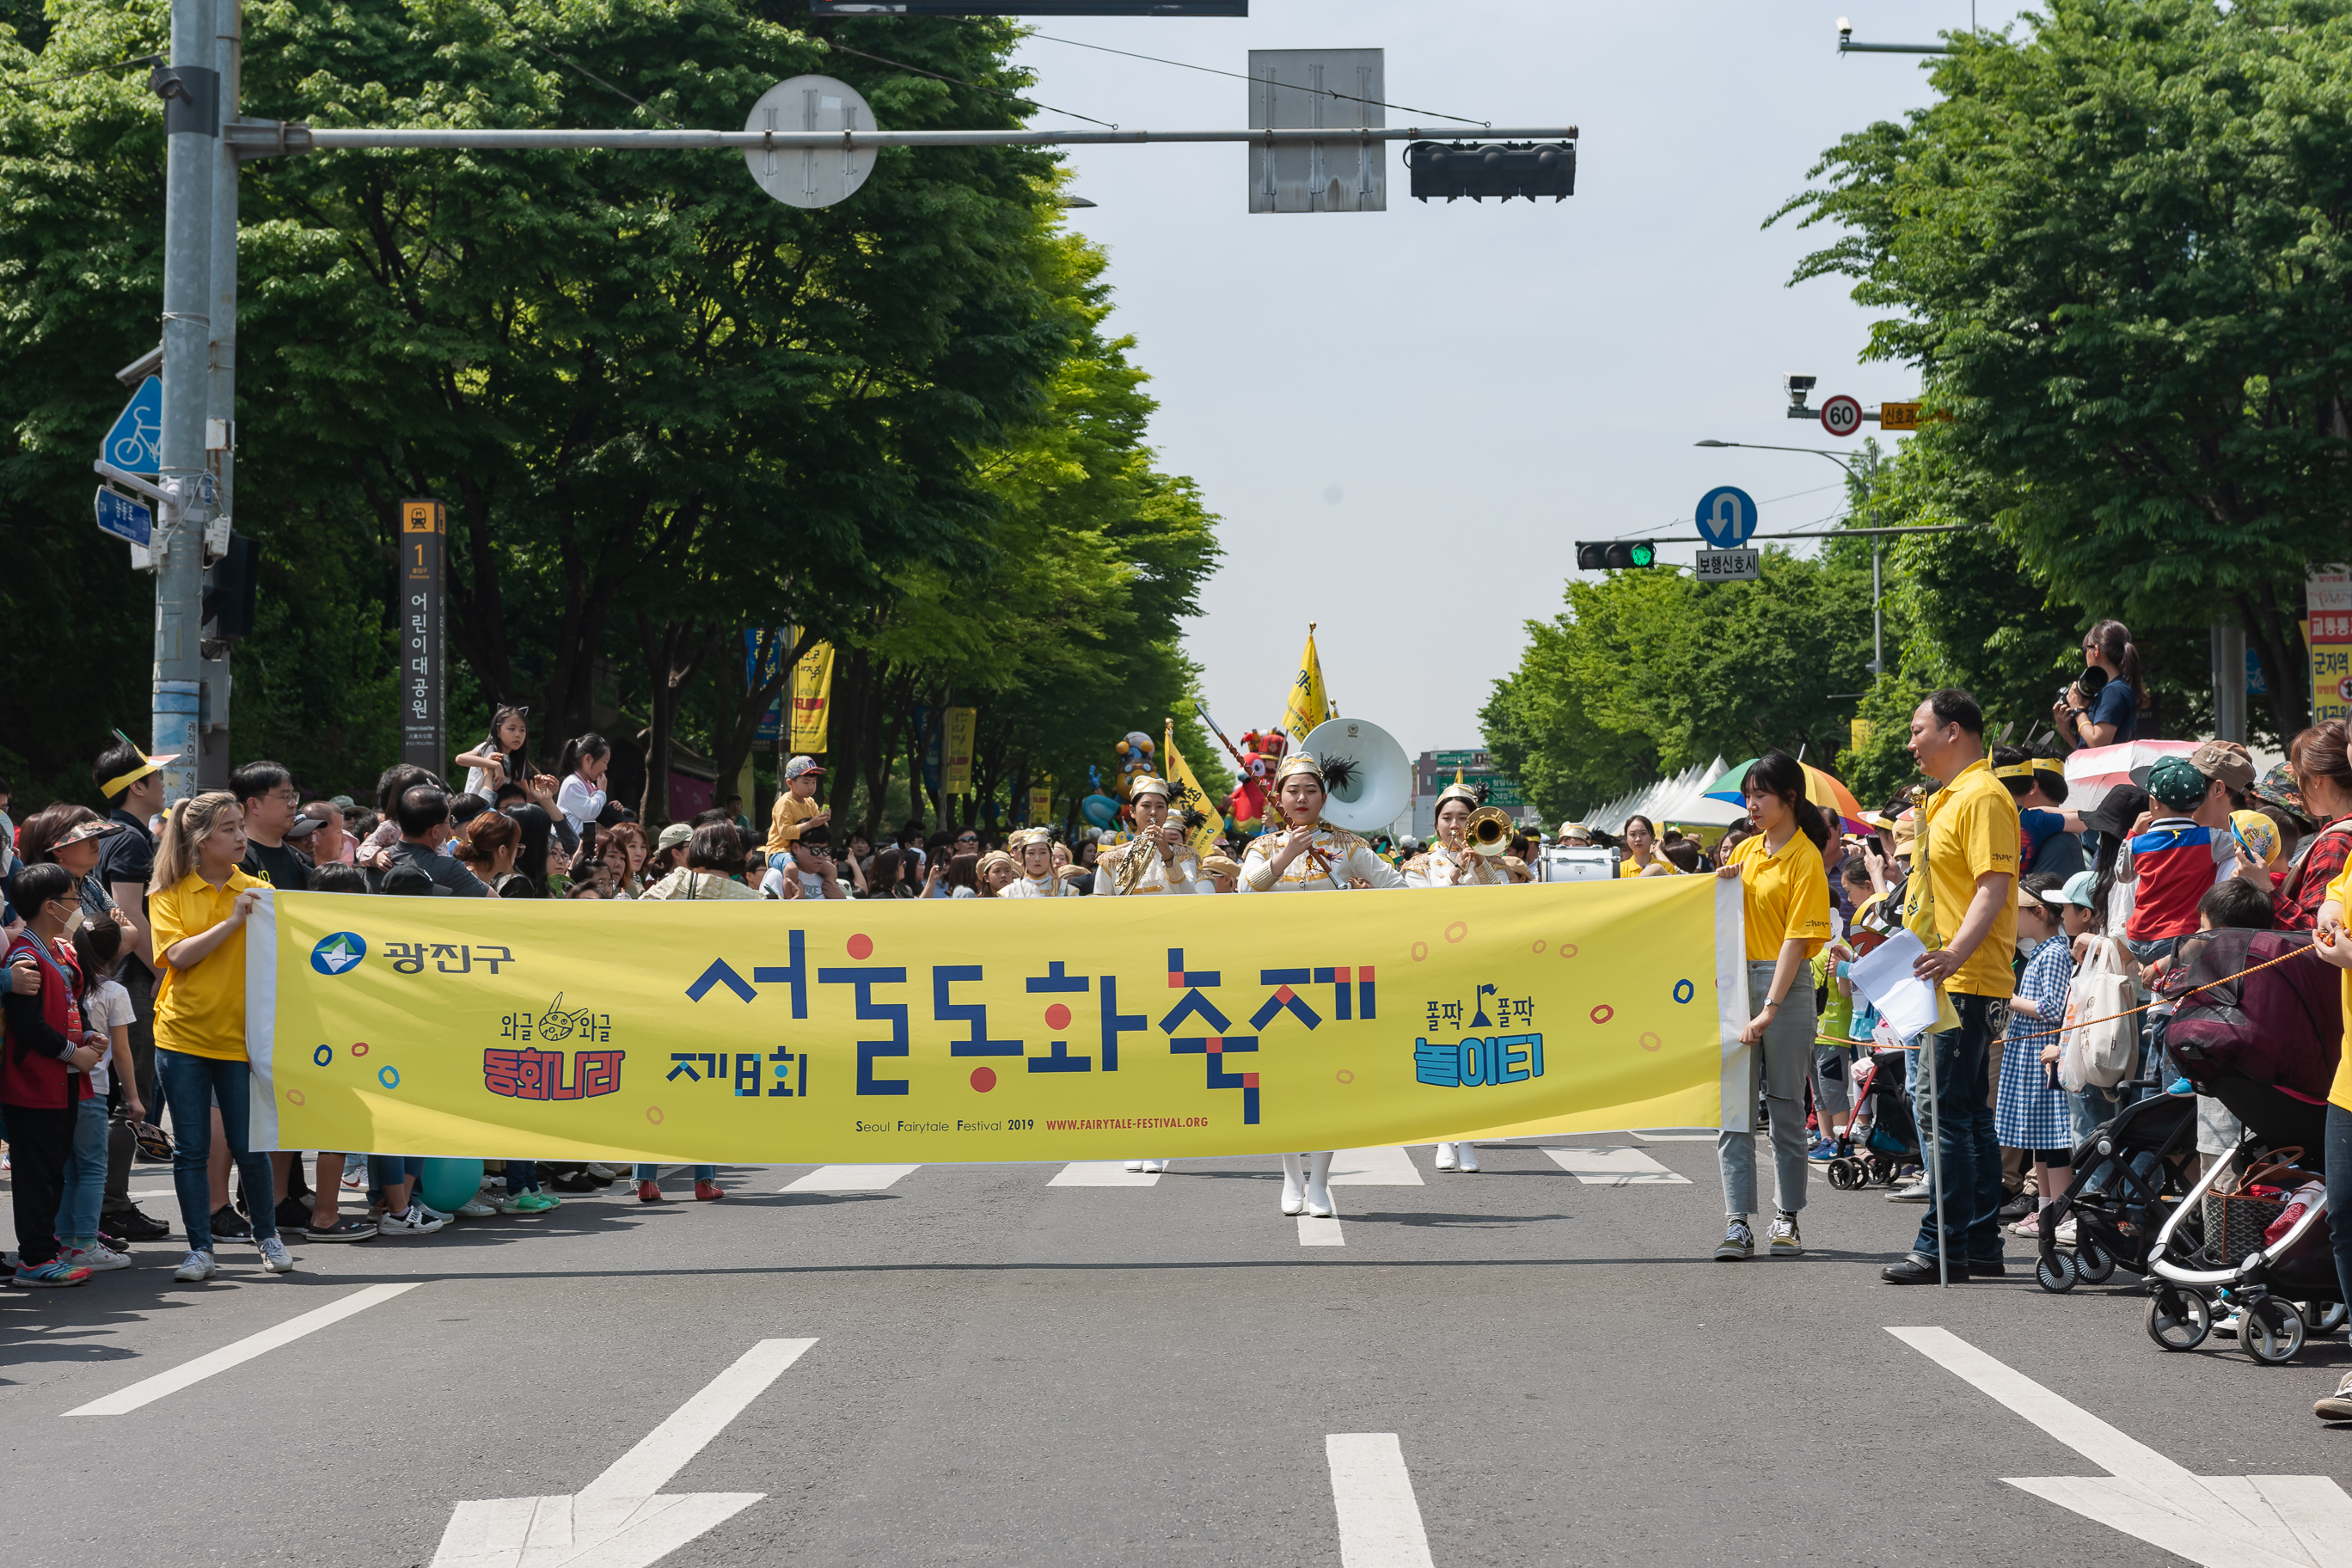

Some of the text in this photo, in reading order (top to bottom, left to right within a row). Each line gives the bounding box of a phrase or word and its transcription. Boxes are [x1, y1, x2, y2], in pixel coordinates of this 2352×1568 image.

[1830, 406, 1853, 426] 60
[414, 543, 422, 566] 1
[1700, 554, 1756, 574] 보행신호시
[2312, 617, 2352, 636] 교통통
[411, 592, 428, 719] 어린이대공원
[2314, 652, 2349, 676] 군자역
[383, 942, 515, 975] 광진구
[500, 1013, 611, 1042] 와글 와글
[685, 929, 1375, 1125] 서울동화축제
[1426, 996, 1534, 1032] 폴짝 폴짝
[483, 1047, 626, 1101] 동화나라
[665, 1045, 807, 1097] 제8회
[1414, 1032, 1544, 1088] 놀이터
[855, 1117, 1209, 1134] Seoul Fairytale Festival 2019 WWW.FAIRYTALE-FESTIVAL.ORG
